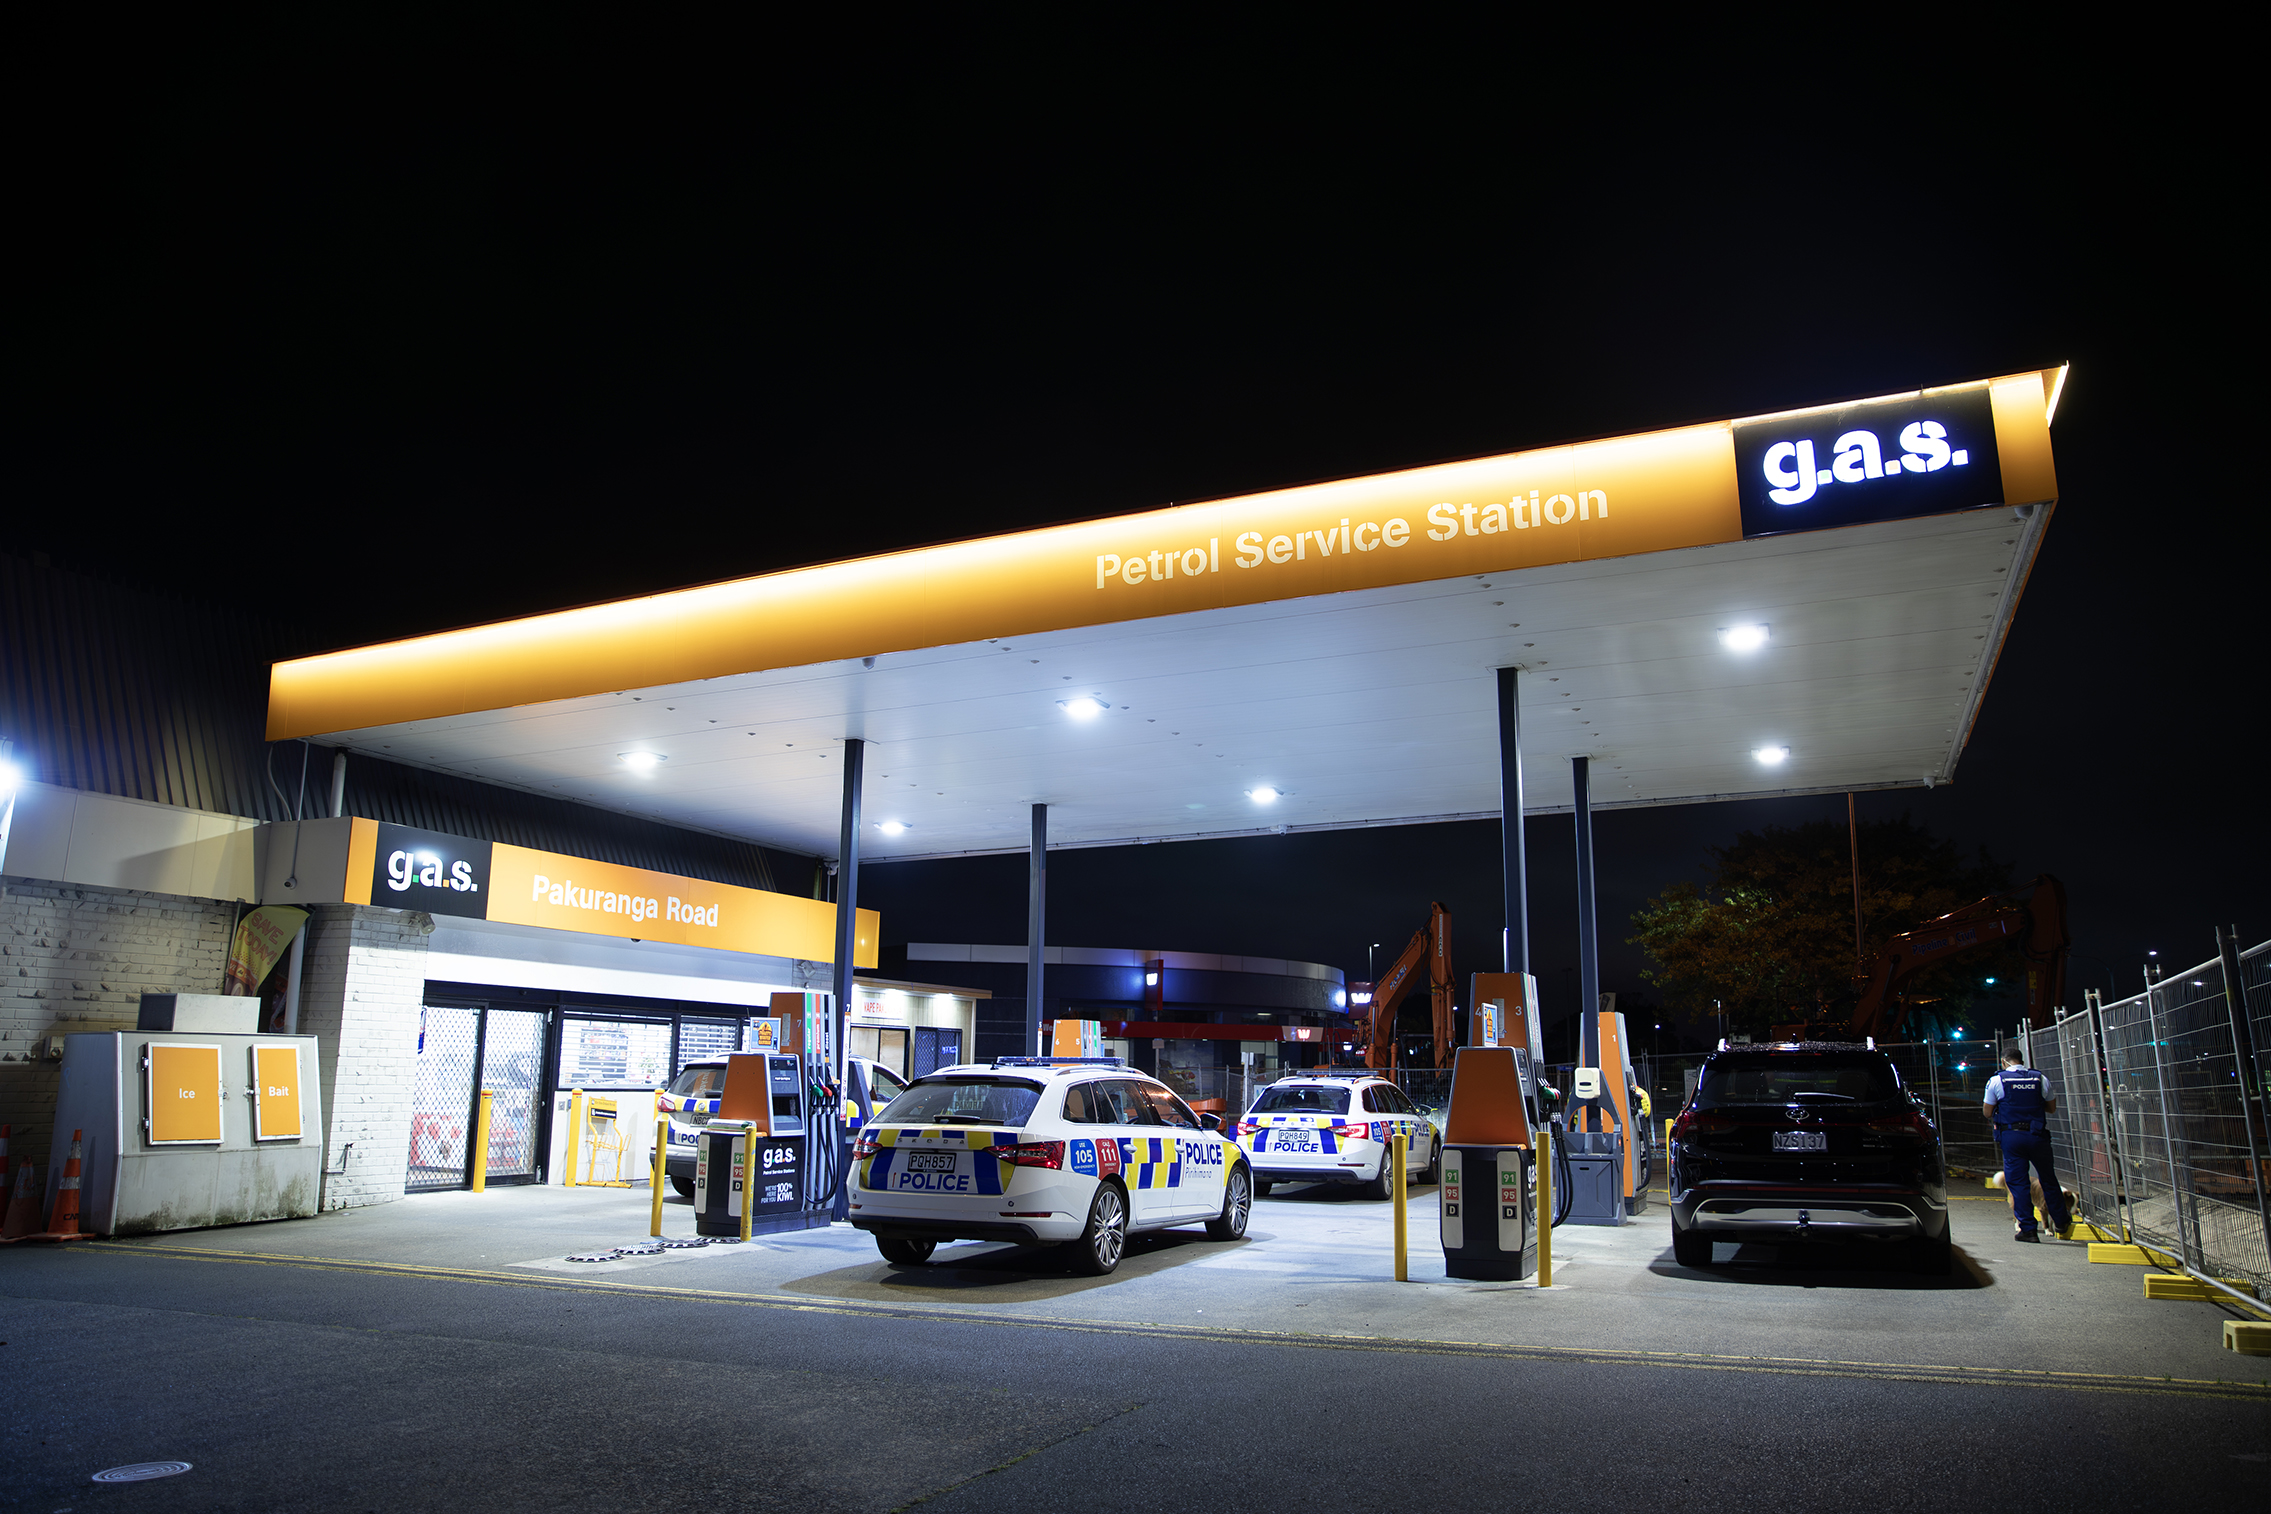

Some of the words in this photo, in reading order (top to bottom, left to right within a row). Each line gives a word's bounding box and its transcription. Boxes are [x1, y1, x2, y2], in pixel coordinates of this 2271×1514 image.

[1762, 419, 1970, 507] g.a.s.
[1095, 537, 1219, 590] Petrol
[1234, 517, 1411, 570] Service
[1426, 488, 1609, 543] Station
[387, 849, 479, 892] g.a.s.
[532, 873, 658, 922] Pakuranga
[666, 895, 719, 928] Road
[251, 911, 285, 945] SAVE
[237, 924, 278, 966] TODAY!
[846, 1003, 851, 1012] 7
[1475, 1006, 1482, 1017] 4
[1515, 1005, 1522, 1016] 3
[796, 1019, 802, 1028] 7
[1612, 1034, 1616, 1043] 1
[178, 1088, 196, 1100] Ice
[268, 1086, 290, 1098] Bait
[1280, 1131, 1308, 1140] PQH849
[1773, 1133, 1825, 1148] NZS137
[1185, 1142, 1222, 1165] POLICE
[1273, 1142, 1319, 1153] POLICE
[763, 1147, 796, 1169] g.a.s.
[1075, 1149, 1093, 1164] 105
[1101, 1148, 1117, 1161] 111
[910, 1155, 953, 1169] PQH857
[734, 1168, 743, 1176] 95
[1447, 1172, 1457, 1181] 91
[899, 1172, 970, 1191] POLICE
[1503, 1174, 1514, 1183] 91
[735, 1182, 741, 1190] D
[1446, 1188, 1458, 1198] 95
[1503, 1190, 1515, 1200] 95
[1449, 1205, 1456, 1215] D
[1506, 1208, 1514, 1217] D
